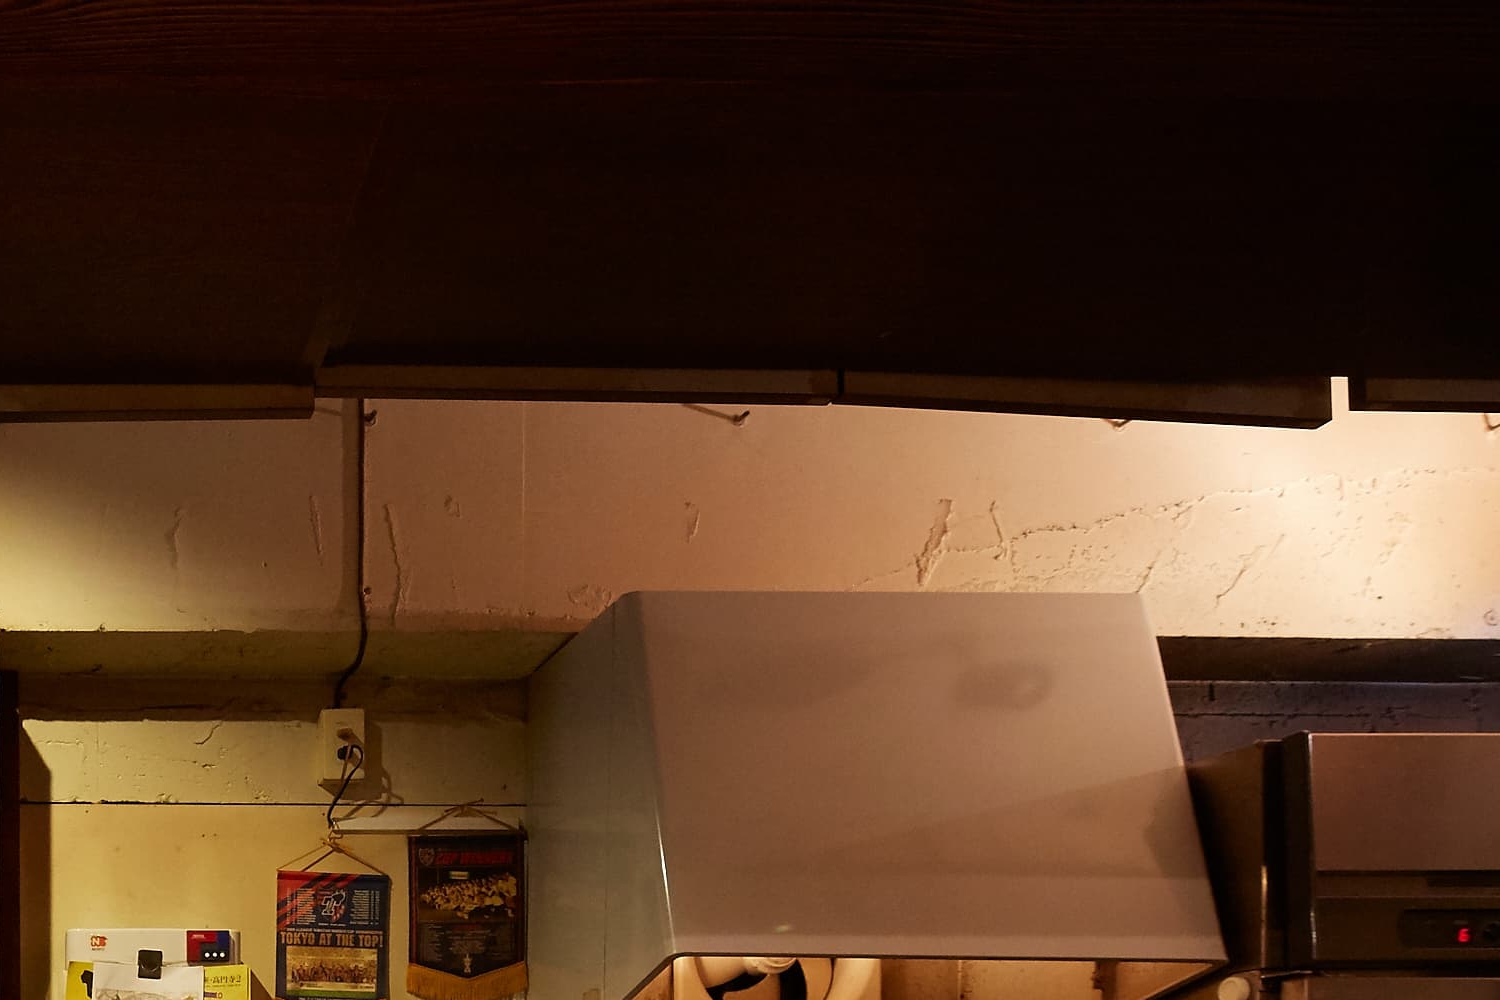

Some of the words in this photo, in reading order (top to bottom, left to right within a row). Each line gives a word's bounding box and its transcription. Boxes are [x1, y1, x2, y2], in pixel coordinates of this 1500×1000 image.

[280, 931, 315, 945] TOKYO
[320, 932, 332, 945] AT
[336, 933, 354, 947] THE
